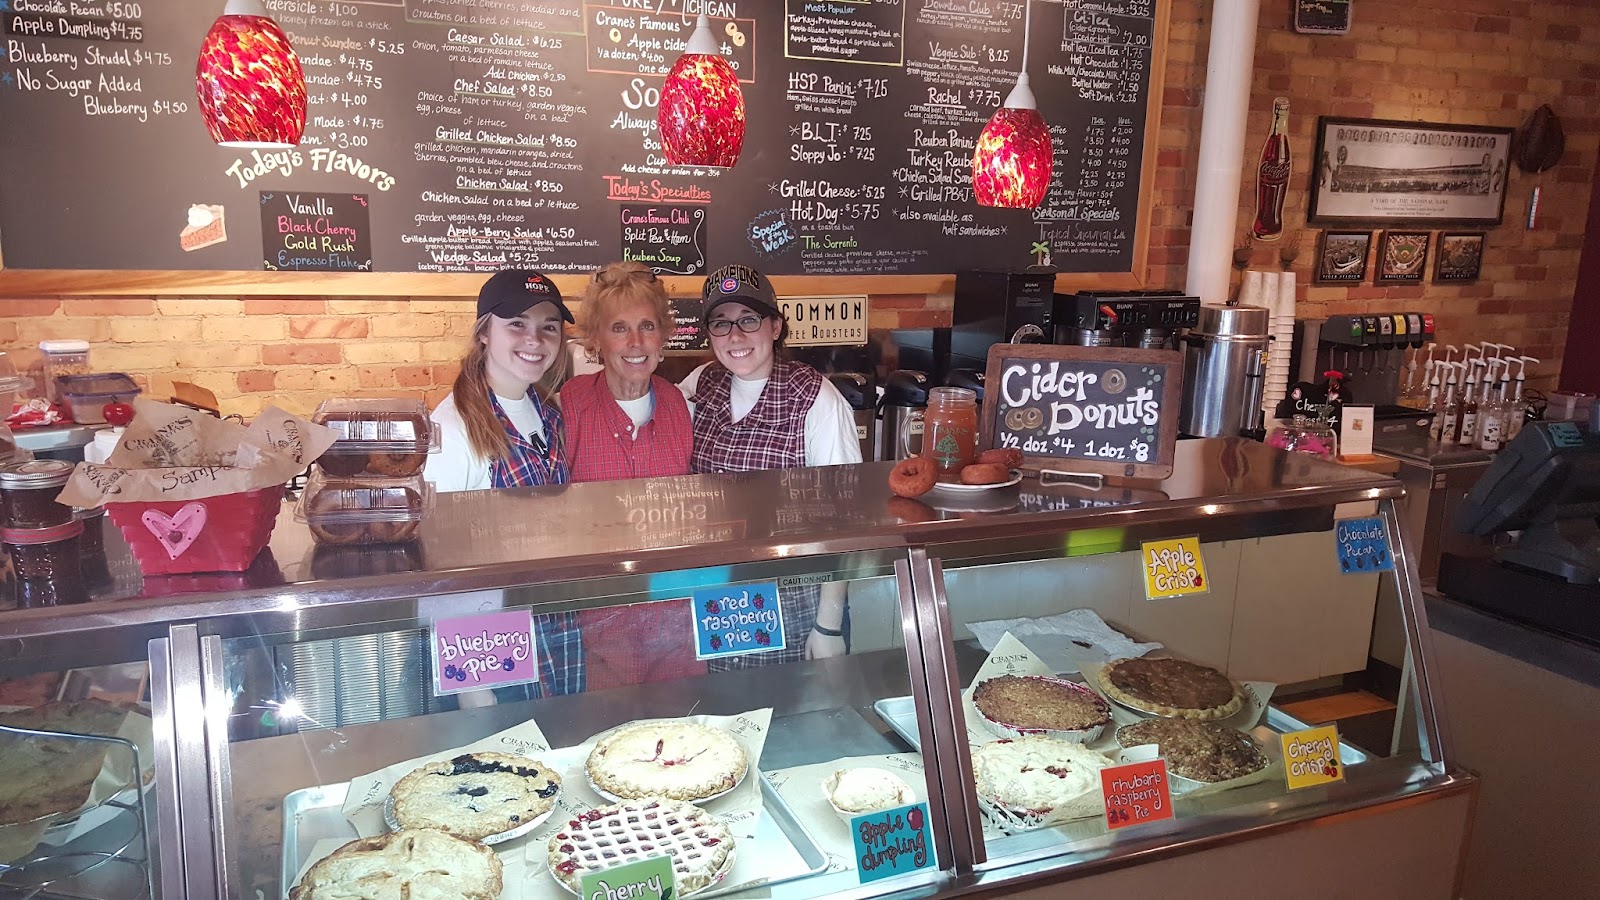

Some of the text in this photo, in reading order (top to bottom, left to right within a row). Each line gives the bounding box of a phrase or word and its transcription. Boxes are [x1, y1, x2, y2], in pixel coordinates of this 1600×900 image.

[71, 2, 142, 18] Pecan $5.00
[804, 4, 856, 15] Most Popular
[996, 2, 1024, 19] $7.75
[1074, 11, 1110, 26] Ci-Tea
[12, 16, 142, 40] Apple Dumpling $4.75
[310, 16, 339, 26] frozen
[513, 16, 546, 30] lettuce
[596, 11, 680, 32] Crane's Famous
[369, 38, 405, 55] $5.25
[447, 28, 563, 49] Caesar $6.25
[627, 33, 661, 51] Apple
[1073, 32, 1110, 43] Iced Hot
[8, 40, 131, 70] Blueberry Strudel
[473, 47, 513, 57] parmesan
[929, 41, 958, 62] Veggie
[1070, 54, 1084, 65] Hot
[340, 54, 374, 72] $4.75
[483, 65, 506, 79] Add
[16, 68, 142, 97] No Sugar Added
[347, 72, 383, 90] $4.75
[454, 78, 553, 97] Chef $8.50
[789, 72, 888, 98] HSP $7.25
[1072, 78, 1112, 89] Bottled Water
[417, 91, 445, 103] Choice
[928, 87, 1001, 107] Rachel $7.75
[1079, 88, 1115, 103] Soft Drink
[84, 95, 148, 122] Blueberry
[477, 117, 508, 128] lettuce
[610, 111, 657, 136] Always
[330, 133, 368, 149] $3.00
[436, 126, 577, 147] Grilled Chicken $8.50
[914, 129, 948, 147] Reuben
[414, 141, 443, 155] grilled
[791, 144, 825, 164] Sloppy
[907, 149, 943, 170] Turkey
[225, 148, 395, 192] Today's Flavors
[898, 168, 953, 184] Chicken Salad
[1260, 160, 1290, 180] Coca-Cola
[456, 175, 497, 189] Chicken
[602, 175, 712, 200] Today's Specialties
[780, 180, 816, 197] Grilled
[422, 191, 580, 210] Chicken lettuce
[911, 185, 943, 202] Grilled
[286, 194, 333, 216] Vanilla
[790, 200, 880, 221] Hot $5.75
[900, 206, 960, 222] also available
[414, 212, 525, 226] garden cheese
[648, 208, 690, 225] Famous Chili
[1032, 207, 1120, 222] Seasonal Specials
[277, 215, 356, 242] Black Cherry
[447, 223, 543, 240] Apple-Berry Salad
[624, 227, 664, 244] Split Pea
[752, 213, 787, 240] Special
[942, 223, 958, 236] half
[284, 234, 355, 252] Gold Rush
[800, 235, 858, 249] The Sorrento
[278, 250, 359, 270] Espresso Flake
[431, 250, 507, 265] Wedge Salad
[623, 247, 681, 266] Reuben Soup
[525, 283, 550, 292] HOPE
[812, 325, 862, 340] ROASTERS
[1002, 362, 1098, 407] Cider
[1047, 387, 1158, 435] Donuts
[124, 415, 193, 452] CRANE'S
[282, 419, 303, 466] CRANE'S
[1000, 432, 1020, 449] 1/2
[1023, 436, 1053, 453] doz.
[1053, 437, 1075, 454] $4
[1084, 440, 1096, 456] 1
[1130, 438, 1149, 461] $8
[1338, 525, 1385, 543] Chocolate
[1148, 544, 1196, 576] Apple
[1344, 544, 1376, 558] Pecan
[719, 591, 749, 611] red
[701, 608, 778, 635] raspberry
[440, 631, 531, 662] blueberry
[724, 628, 752, 648] pie
[990, 653, 1028, 666] CRANE'S
[462, 653, 502, 685] pie
[736, 715, 764, 734] CRANE'S
[501, 735, 547, 753] CRANE'S
[1288, 737, 1335, 762] Cherry
[1112, 769, 1162, 793] rhubarb
[1106, 787, 1163, 811] raspberry
[1133, 804, 1150, 820] Pie
[859, 813, 905, 849] apple
[861, 830, 927, 871] dumpling
[591, 874, 662, 900] cherry
